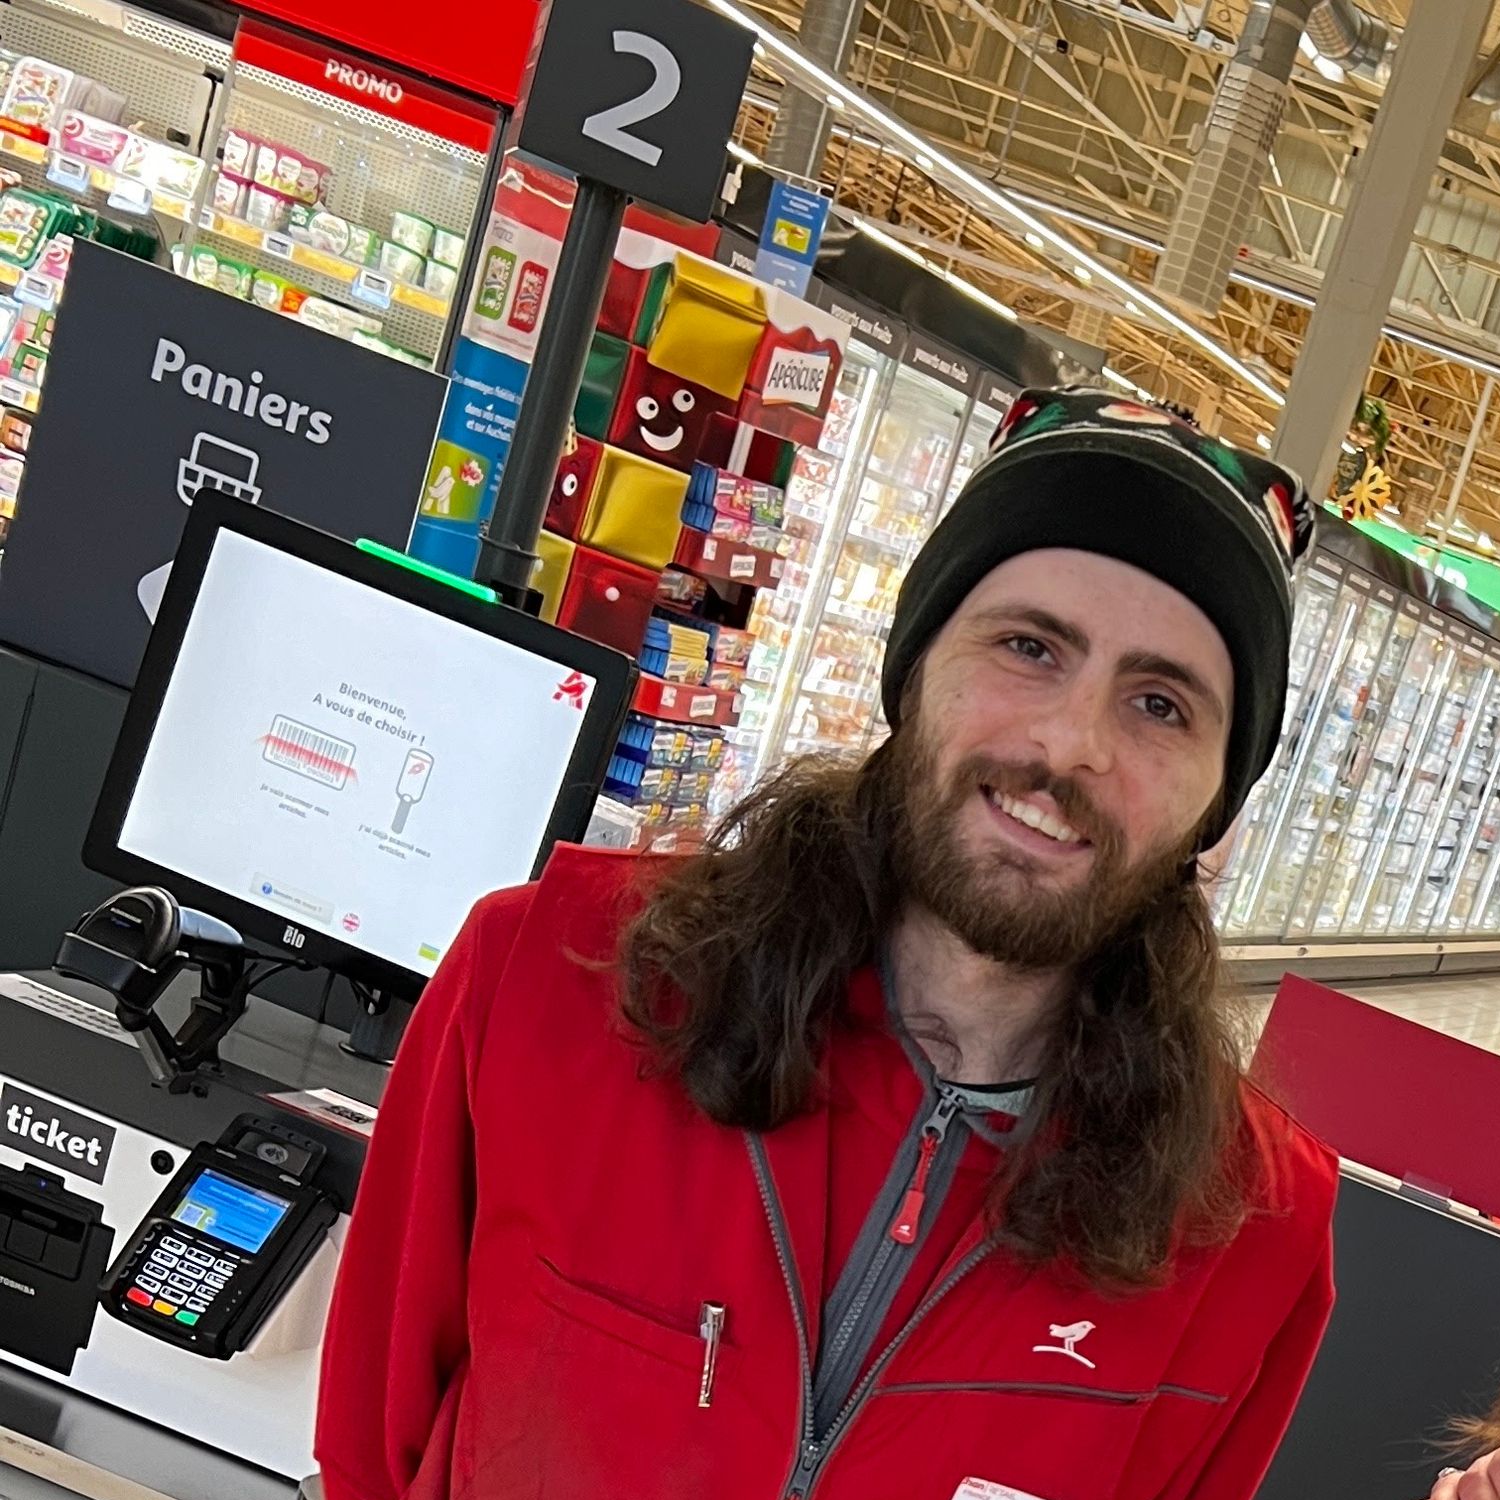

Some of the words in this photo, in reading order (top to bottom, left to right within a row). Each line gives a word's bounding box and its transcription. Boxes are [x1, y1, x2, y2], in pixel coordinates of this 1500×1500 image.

[324, 58, 403, 104] PROMO
[581, 30, 682, 167] 2
[150, 338, 332, 445] Paniers
[769, 359, 823, 394] APÉRICUBE
[312, 692, 323, 705] A
[326, 699, 354, 719] vous
[357, 711, 373, 726] de
[374, 718, 418, 744] choisir
[419, 735, 426, 747] !
[339, 682, 407, 721] Bienvenue,
[6, 1103, 103, 1167] ticket
